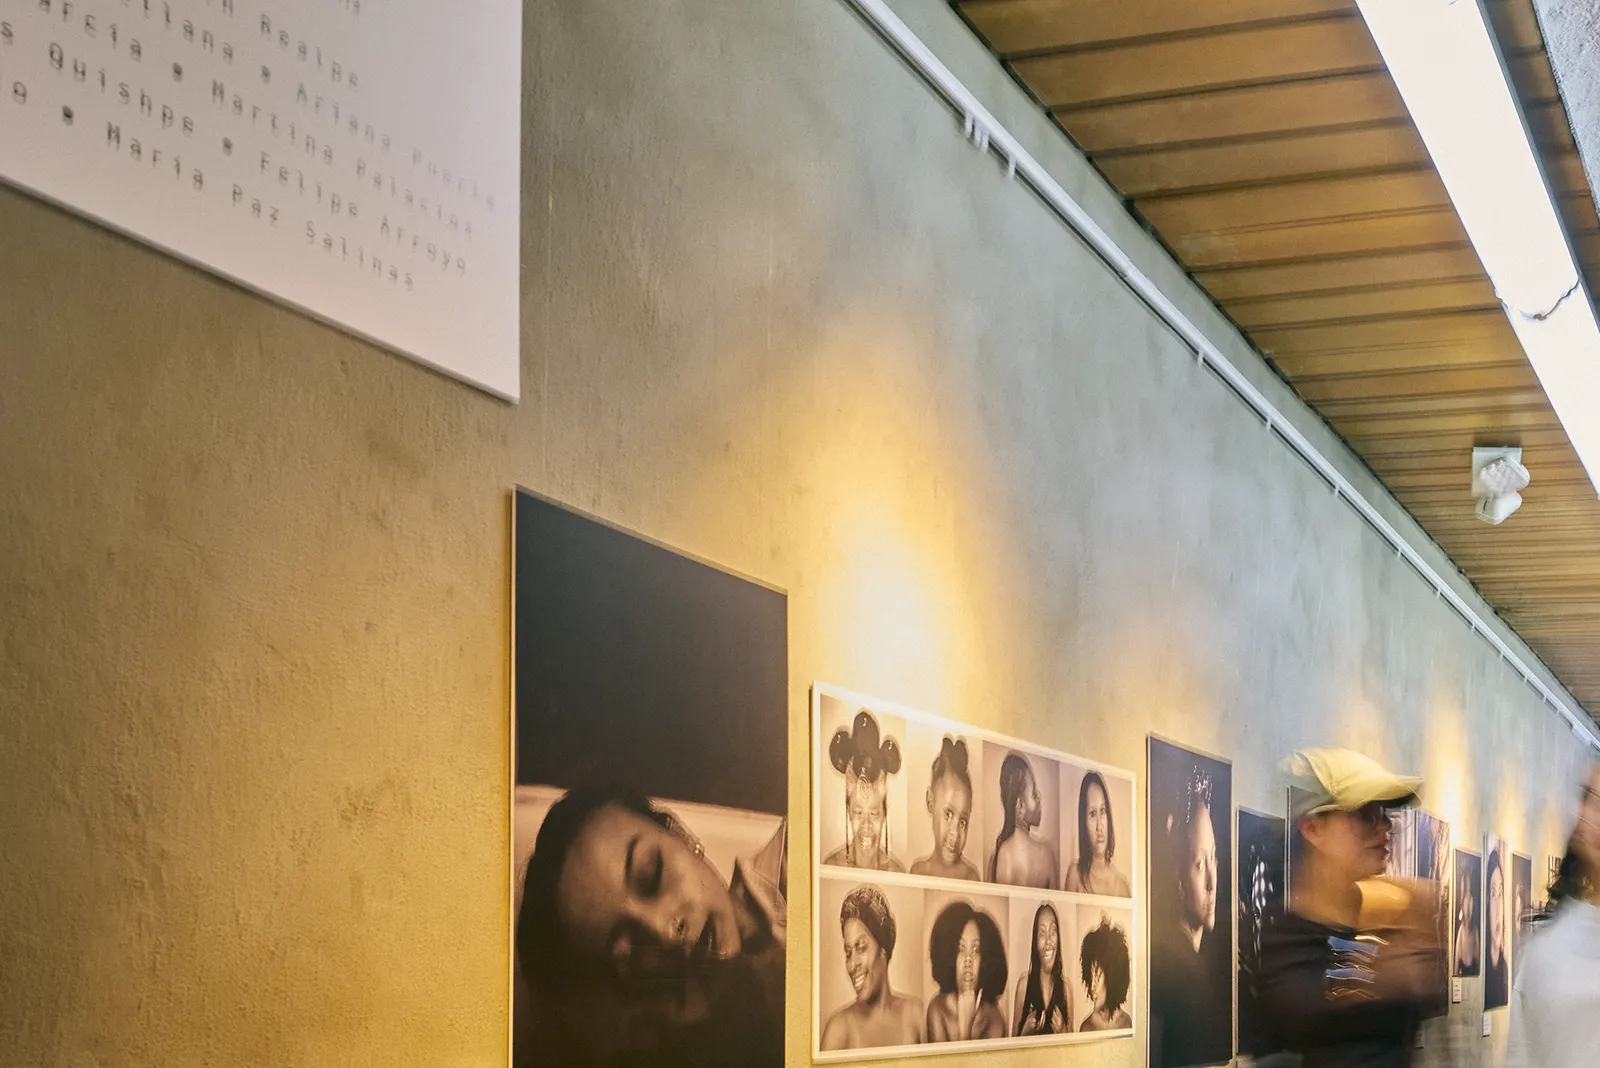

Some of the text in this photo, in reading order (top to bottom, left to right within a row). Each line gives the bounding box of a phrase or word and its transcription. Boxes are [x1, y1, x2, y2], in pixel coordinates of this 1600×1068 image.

[49, 42, 194, 136] Quishpe
[260, 153, 358, 219] Felipe
[380, 216, 466, 276] Arroyo
[212, 79, 333, 164] Martina
[296, 83, 391, 152] Ariana
[232, 184, 280, 227] Paz
[306, 221, 414, 291] Salinas
